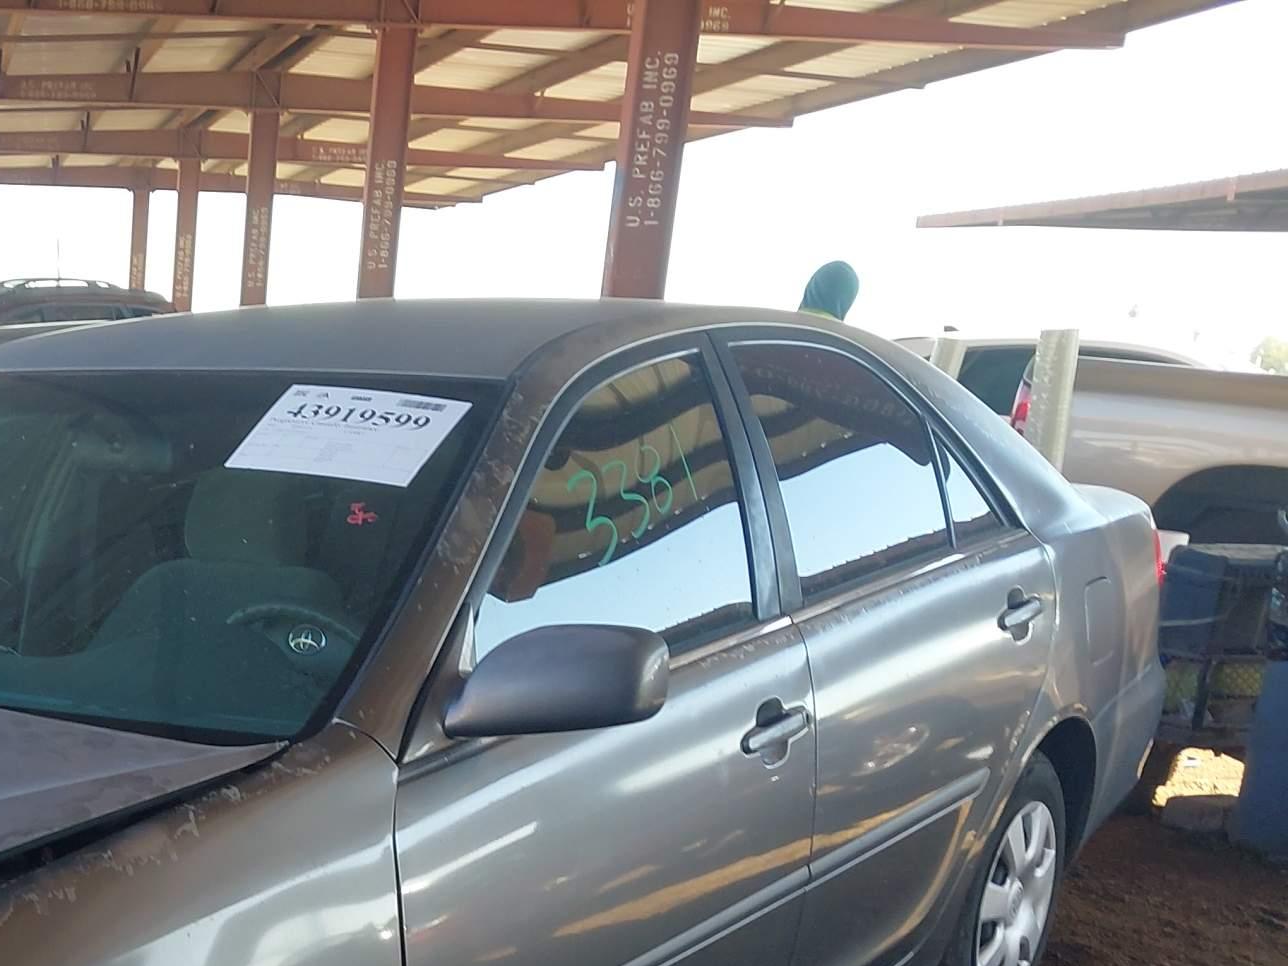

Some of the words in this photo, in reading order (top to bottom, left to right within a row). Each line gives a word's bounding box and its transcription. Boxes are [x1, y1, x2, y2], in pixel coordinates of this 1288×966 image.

[642, 50, 662, 90] INC.
[632, 100, 655, 179] PREFAB
[643, 52, 680, 226] 1-866-799-0969
[626, 190, 645, 228] U.S.
[287, 402, 431, 432] 43919599
